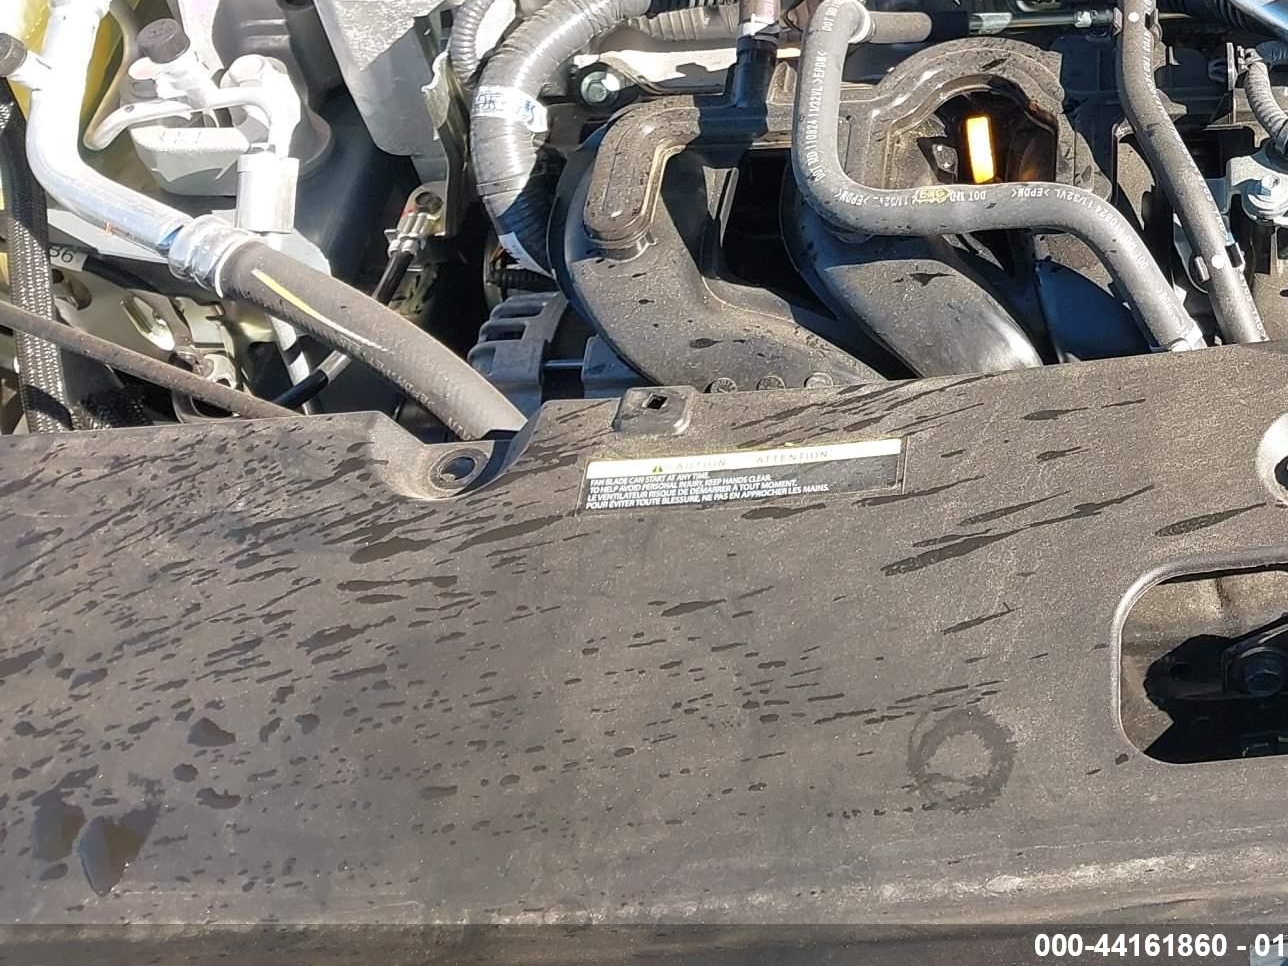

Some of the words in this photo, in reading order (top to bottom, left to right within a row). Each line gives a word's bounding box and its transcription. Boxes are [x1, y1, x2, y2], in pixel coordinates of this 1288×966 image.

[808, 164, 826, 183] DOT
[969, 190, 987, 201] DOT
[756, 451, 828, 463] ATTENTION
[589, 486, 600, 494] TO
[600, 485, 618, 493] HELP
[619, 484, 641, 492] AVOID
[641, 481, 678, 491] PERSONAL
[704, 478, 721, 486] KEEP
[722, 476, 748, 484] HANDS
[748, 474, 772, 483] CLEAR.
[605, 478, 628, 486] BLADE
[629, 477, 645, 485] CAN
[645, 475, 667, 484] START
[667, 474, 676, 482] AT
[676, 473, 692, 481] ANY
[585, 501, 609, 510] POUR
[636, 497, 661, 506] TOUTE
[701, 494, 713, 502] NE
[713, 492, 729, 501] PAS
[729, 491, 740, 499] EN
[740, 488, 787, 499] APPROCHER
[788, 486, 801, 495] LES
[802, 483, 831, 493] MAINS.
[587, 494, 597, 502] LE
[597, 491, 648, 501] VENTILATEUR
[648, 489, 677, 498] RISQUE
[677, 488, 689, 496] DE
[739, 482, 760, 491] TOUT
[760, 479, 798, 489] MOMENT.
